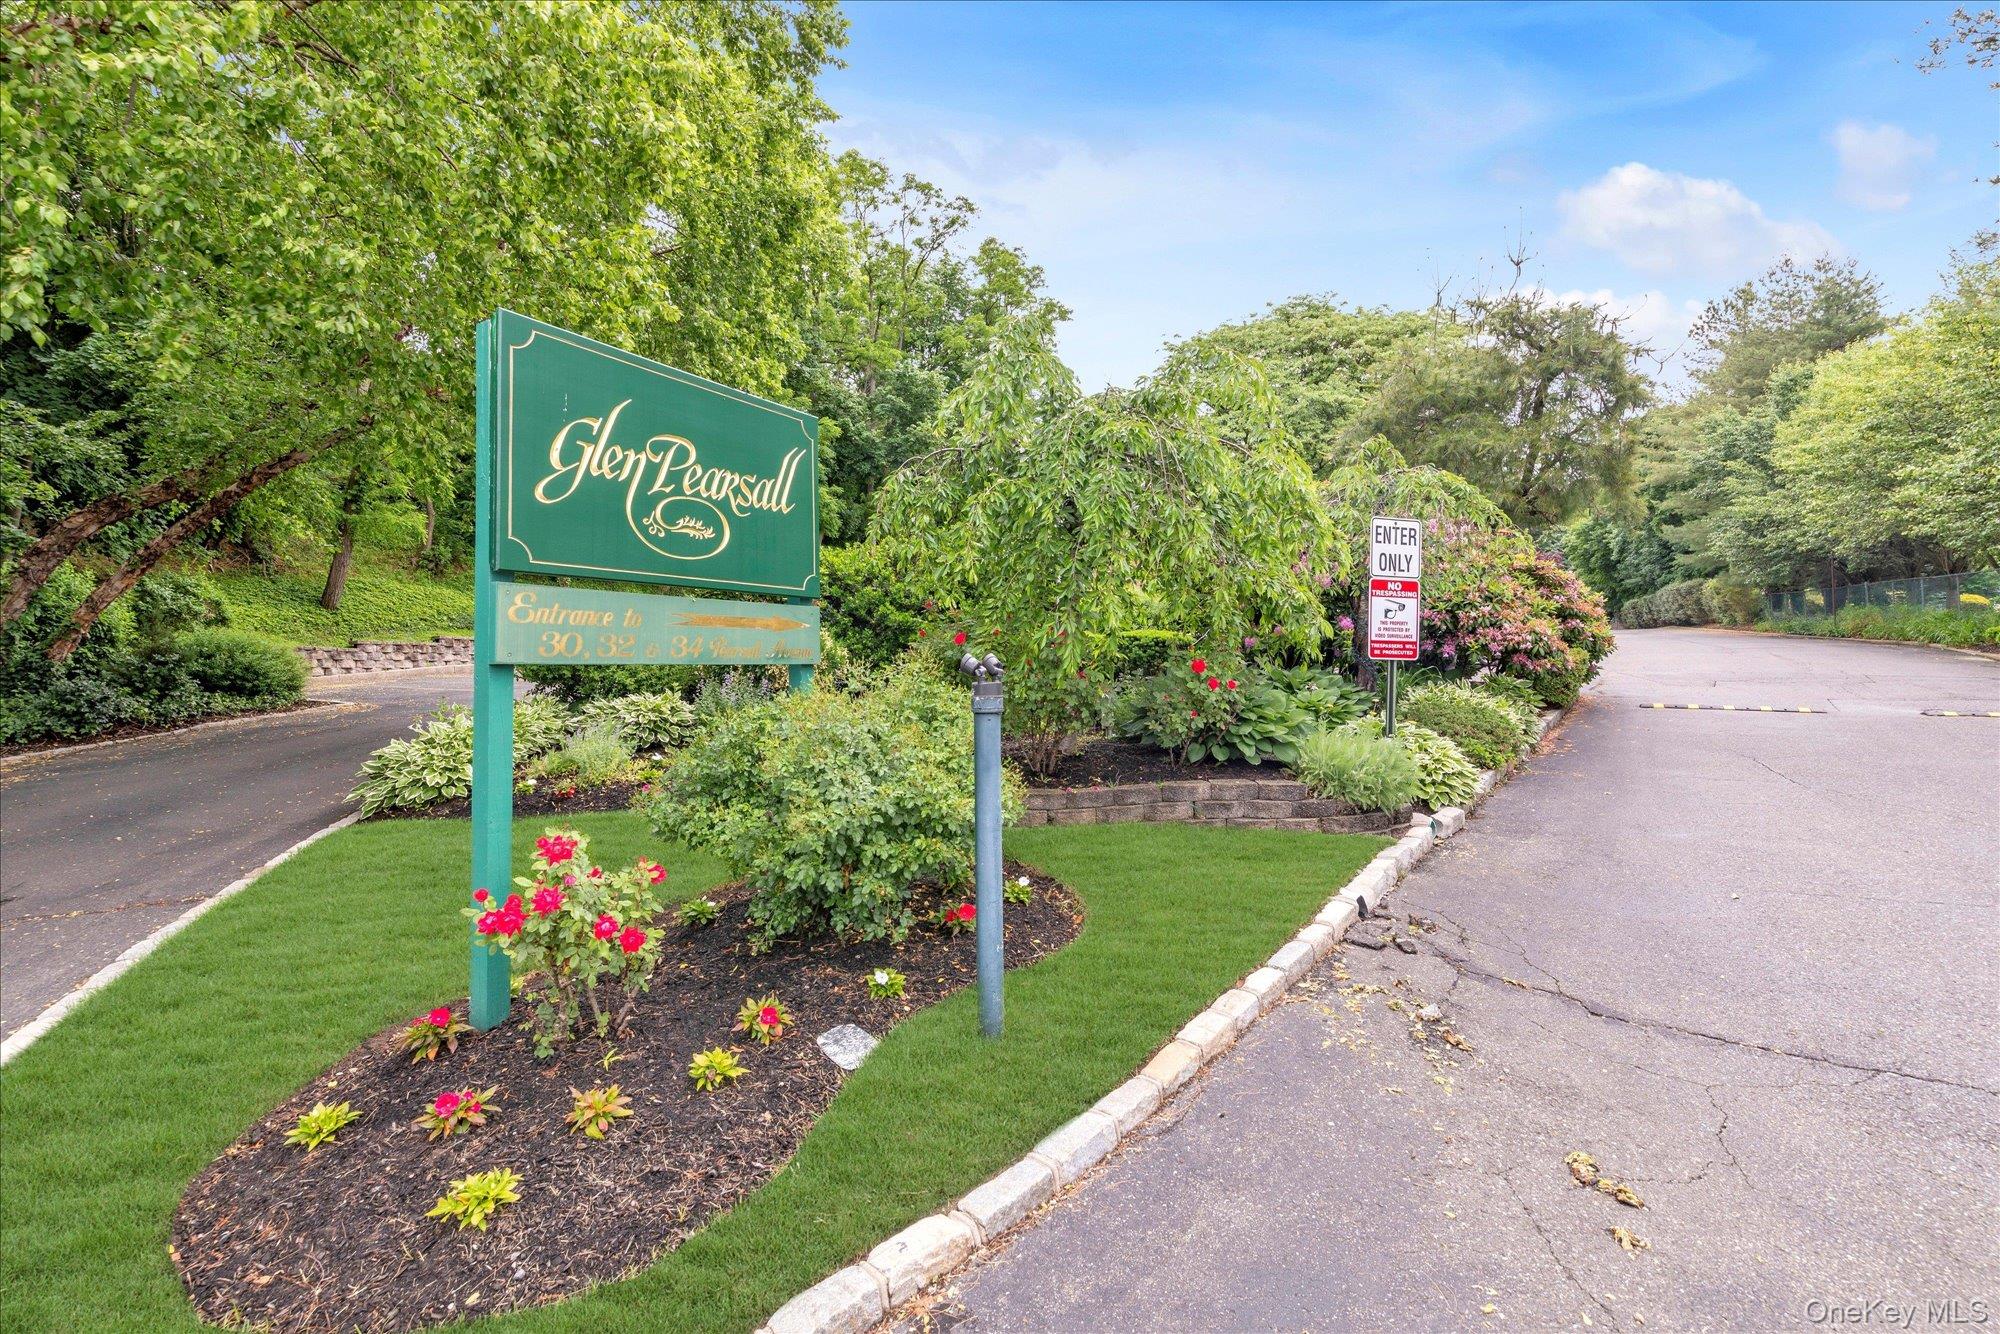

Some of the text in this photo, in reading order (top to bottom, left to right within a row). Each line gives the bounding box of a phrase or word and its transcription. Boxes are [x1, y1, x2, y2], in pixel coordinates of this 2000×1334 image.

[645, 434, 806, 517] Pearsall
[1375, 525, 1417, 546] ENTER
[1379, 552, 1413, 573] ONLY
[1387, 582, 1402, 590] NO
[507, 591, 642, 628] Entrance to
[538, 631, 591, 659] 30,
[599, 634, 637, 658] 32
[671, 635, 704, 658] 34
